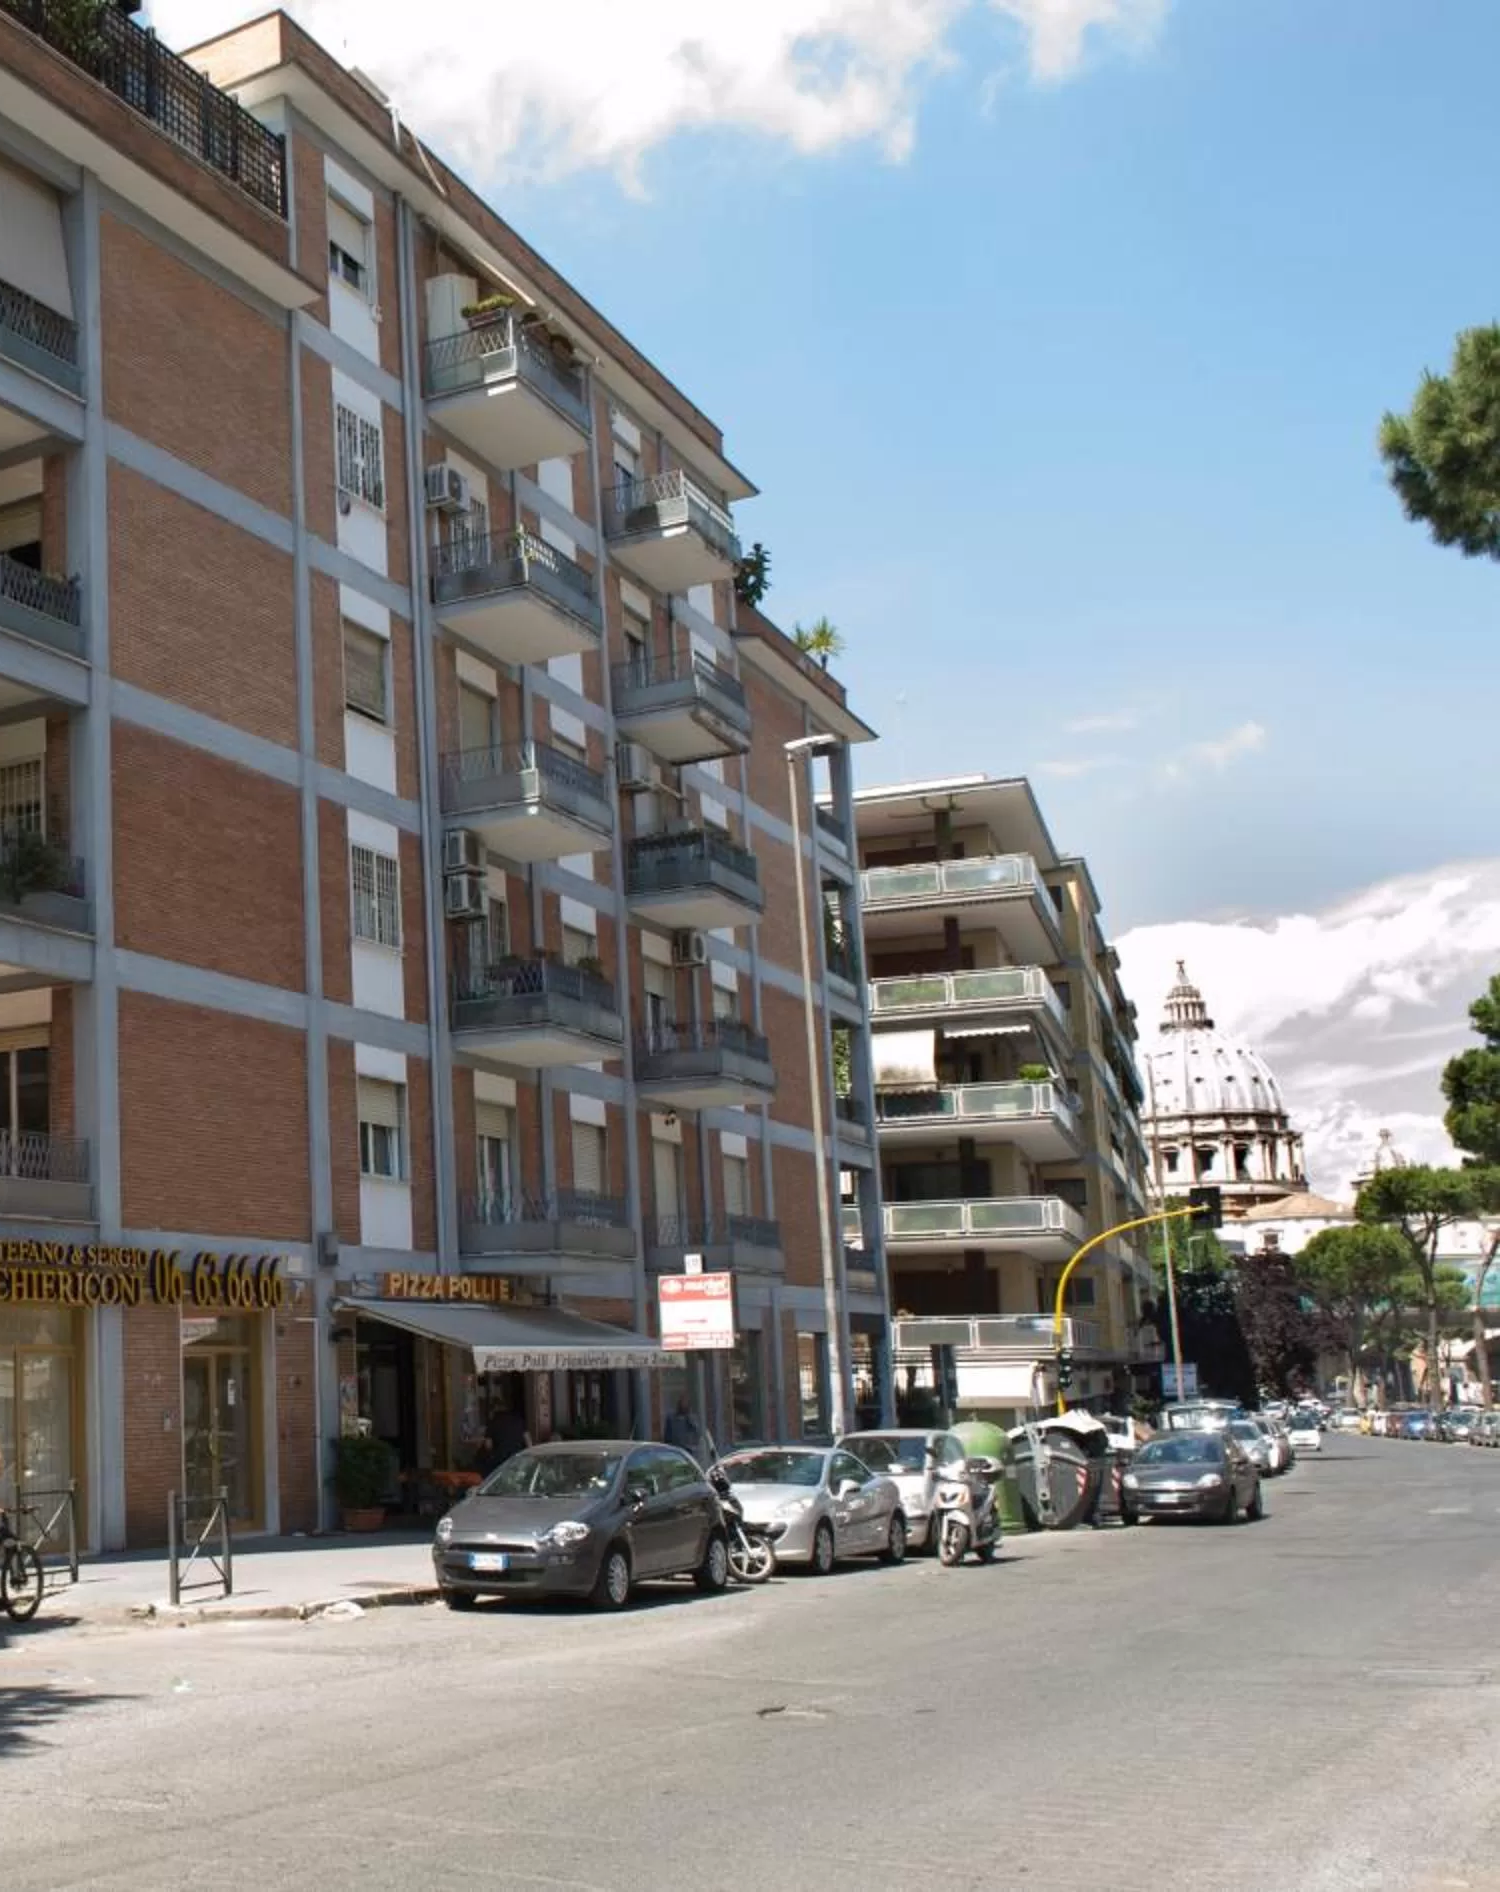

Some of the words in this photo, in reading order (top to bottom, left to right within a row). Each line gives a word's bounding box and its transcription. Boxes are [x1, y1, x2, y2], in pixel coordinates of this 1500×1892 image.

[71, 1248, 83, 1265] &
[87, 1246, 150, 1272] SERGIO
[153, 1248, 184, 1304] 06
[390, 1272, 444, 1298] PIZZA
[450, 1276, 496, 1299] POLLI
